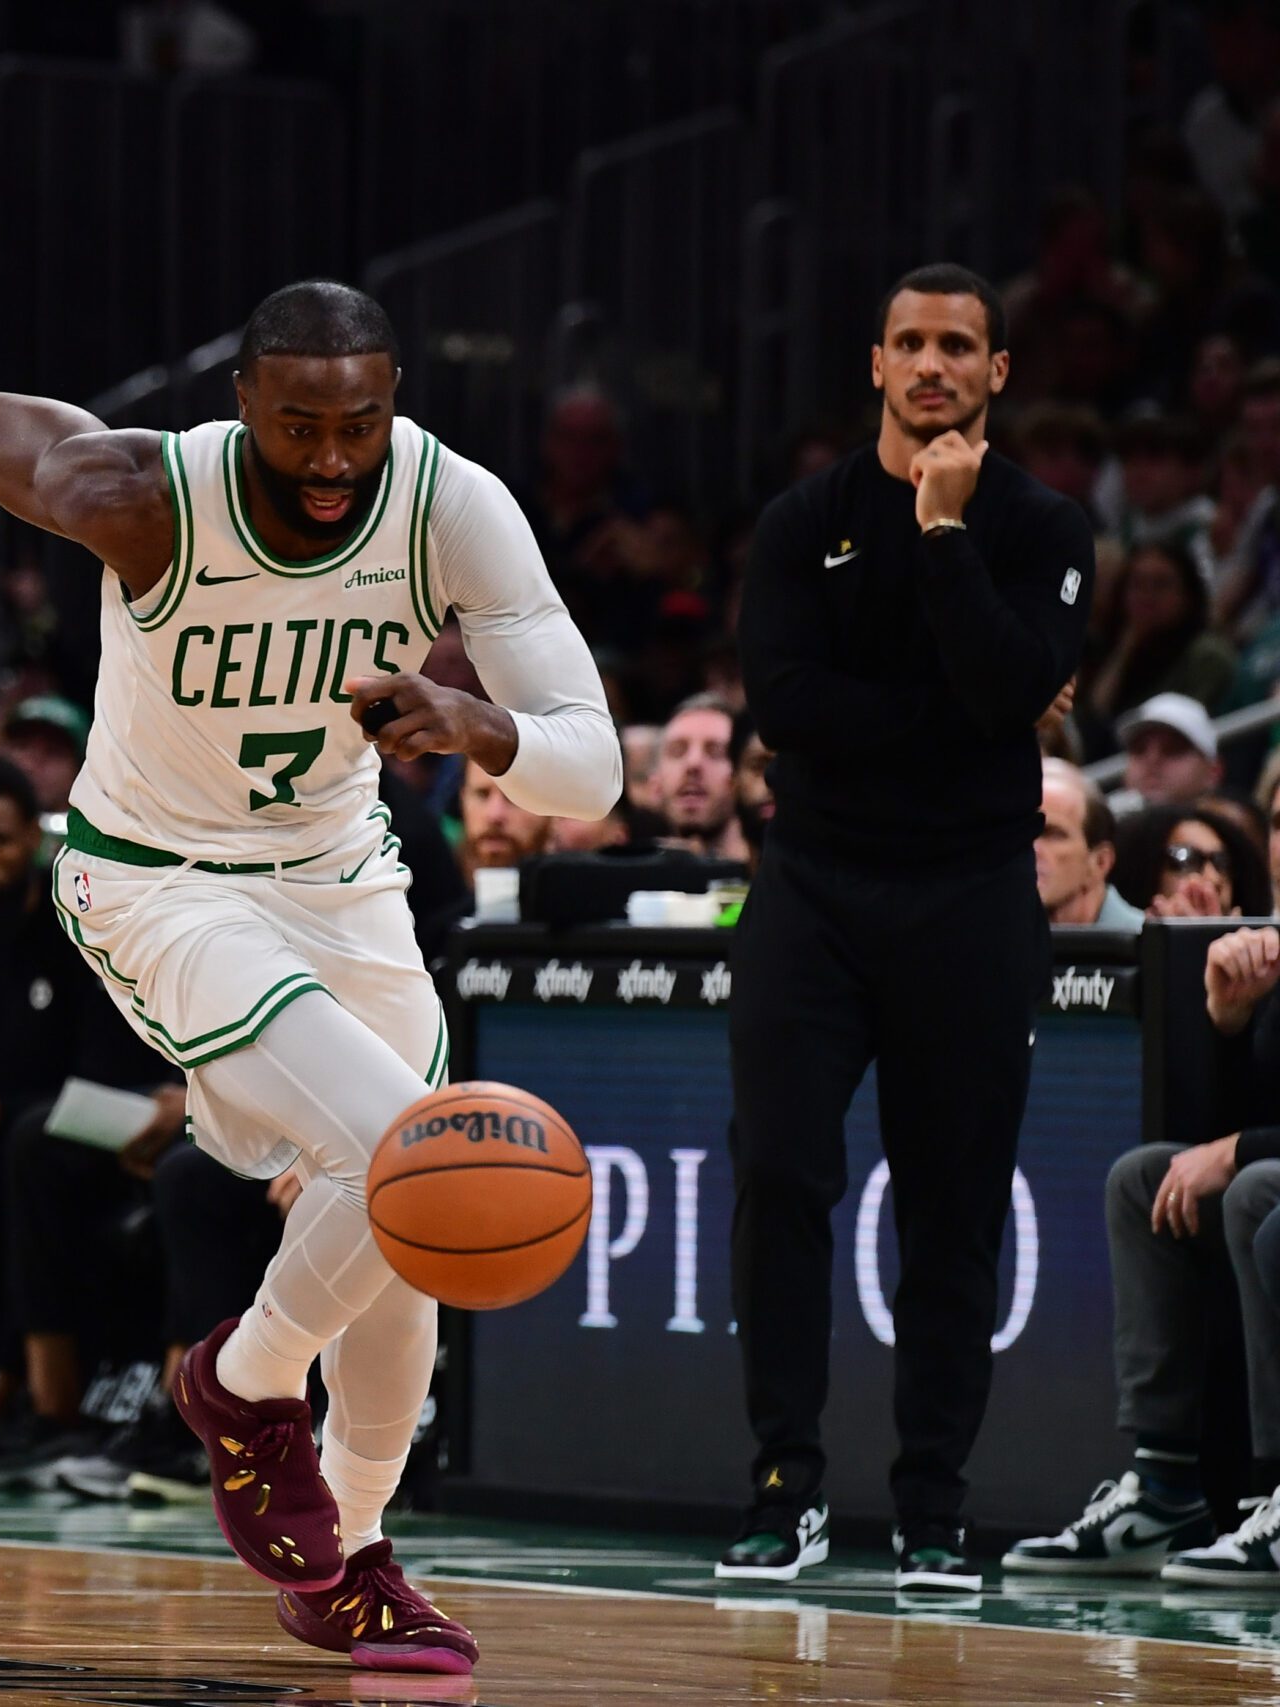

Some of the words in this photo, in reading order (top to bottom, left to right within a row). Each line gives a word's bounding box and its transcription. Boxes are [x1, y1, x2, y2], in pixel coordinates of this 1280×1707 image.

[344, 567, 406, 589] Amica
[172, 618, 410, 708] CELTICS
[238, 726, 326, 811] 7
[533, 958, 593, 1002] xfinity
[617, 959, 677, 1004] xfinity
[1051, 965, 1115, 1011] xfinity
[401, 1111, 548, 1153] Wilson
